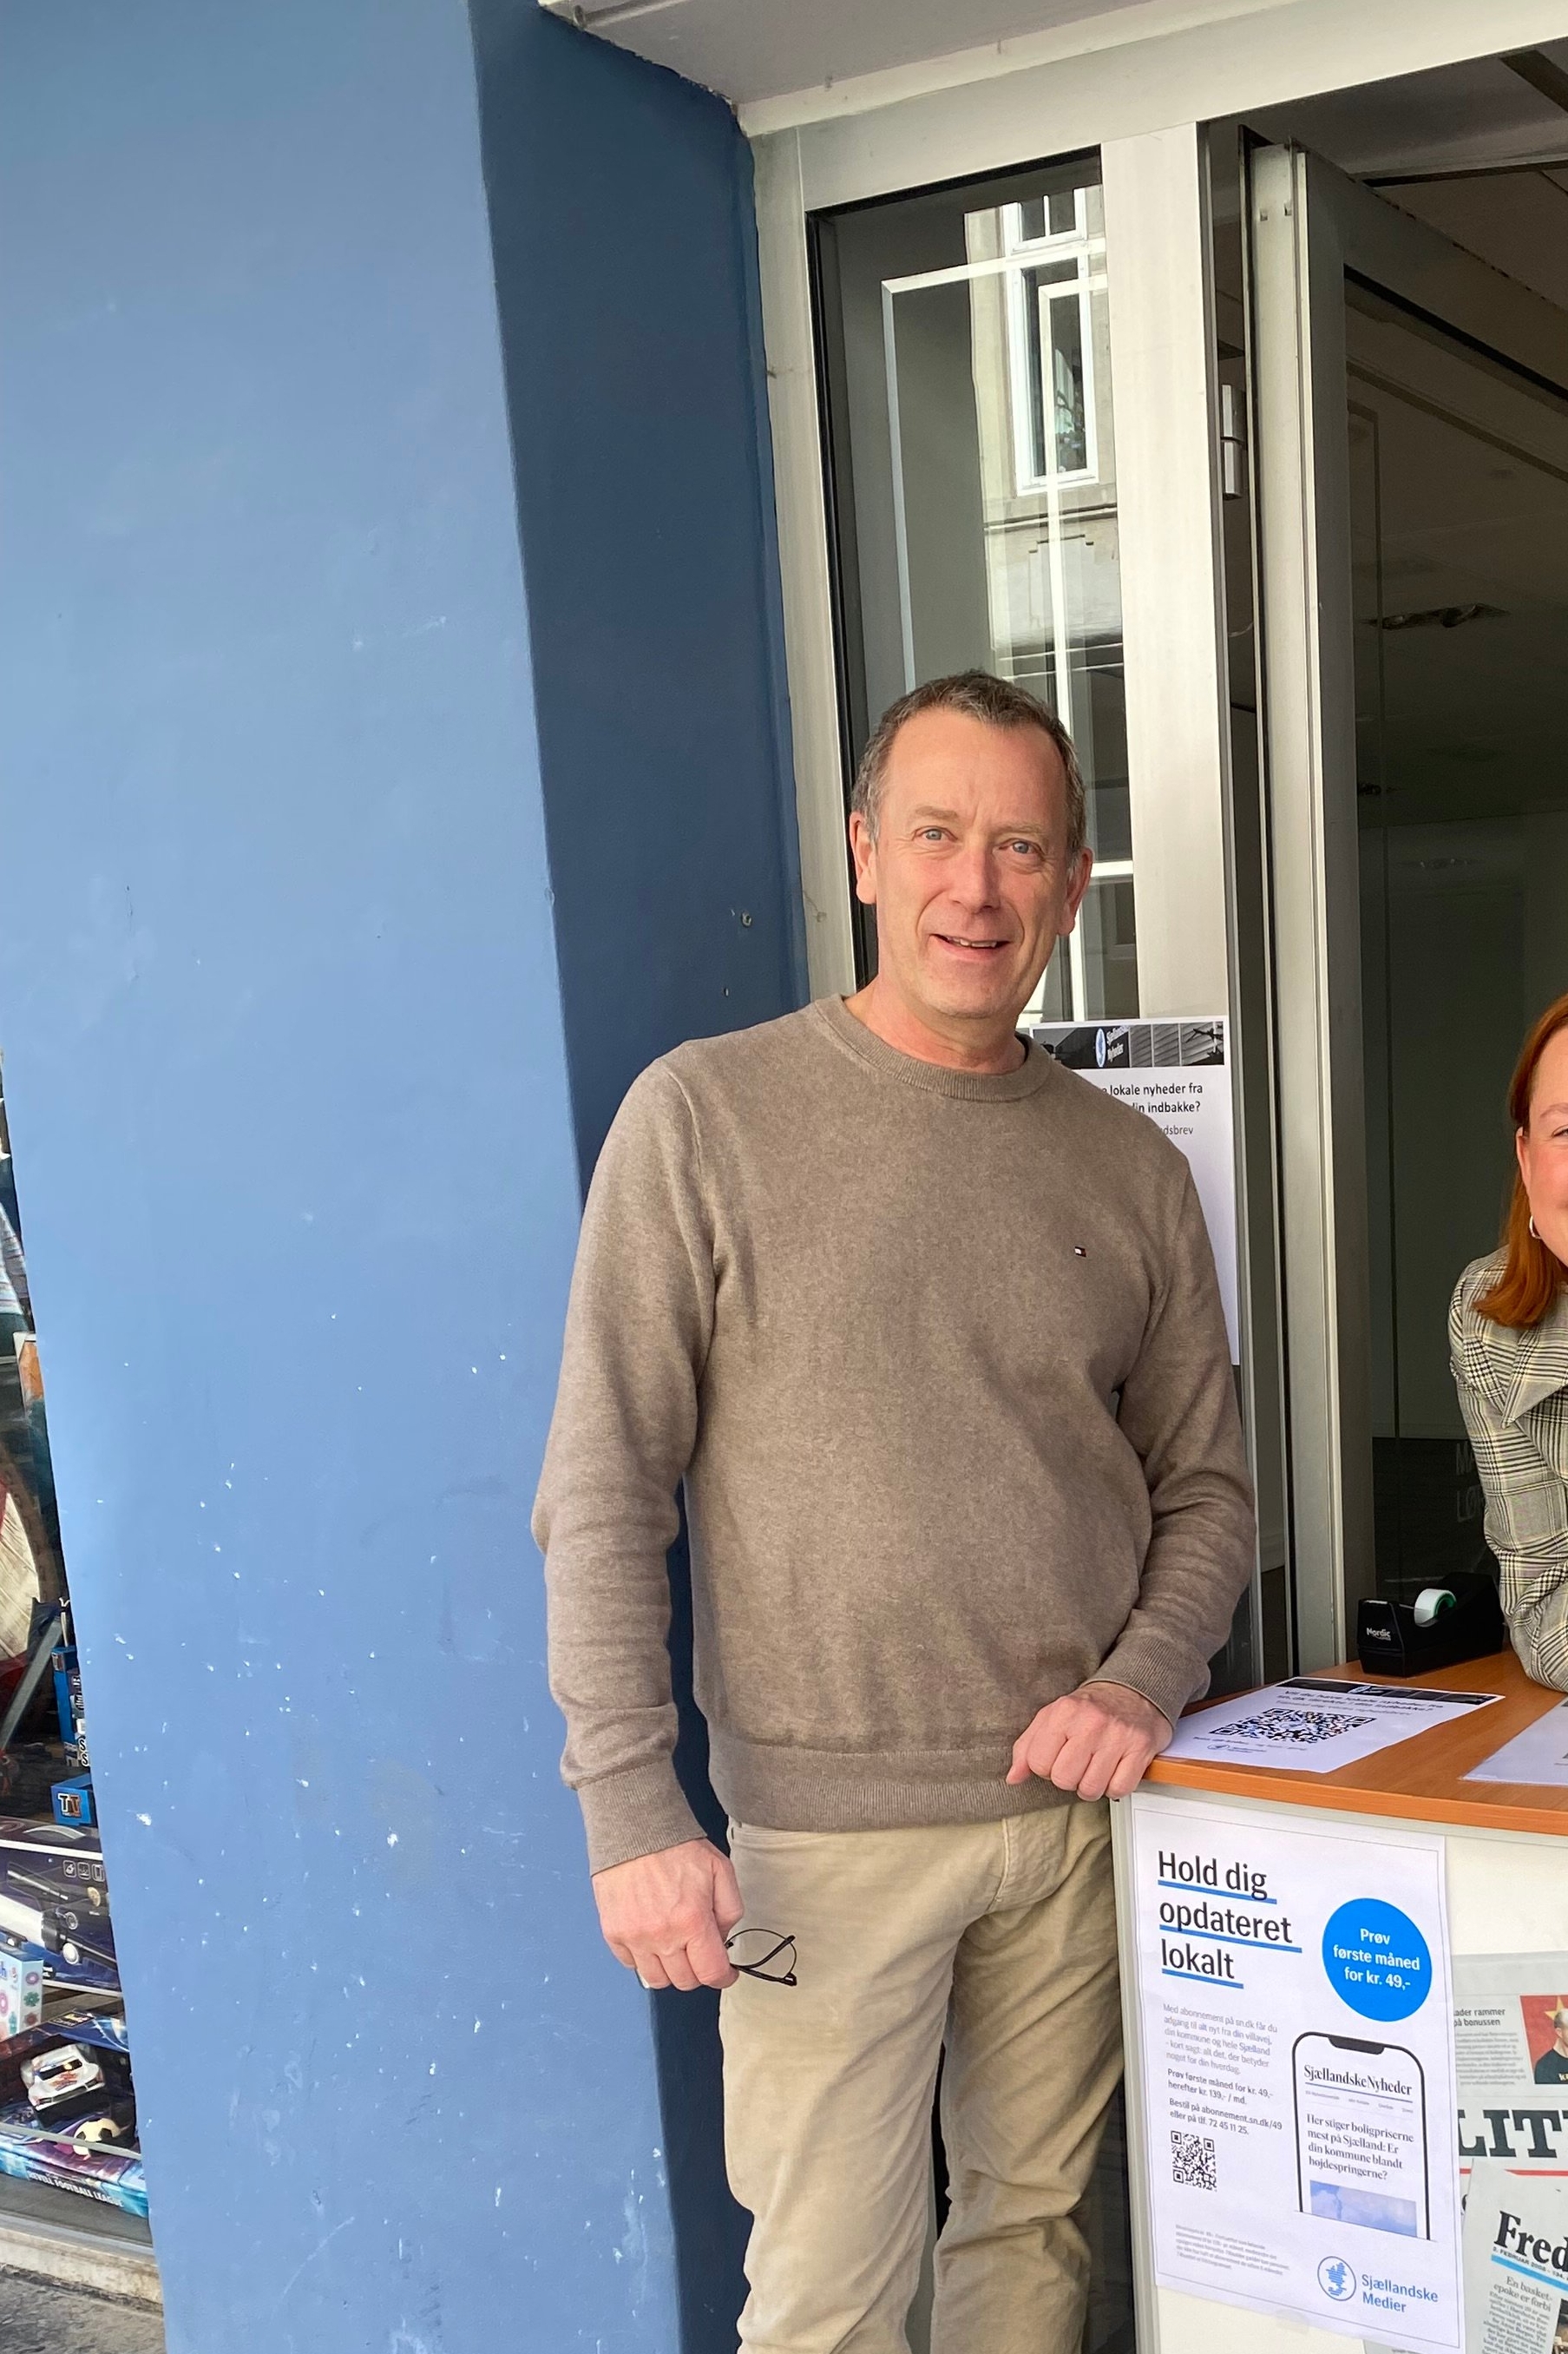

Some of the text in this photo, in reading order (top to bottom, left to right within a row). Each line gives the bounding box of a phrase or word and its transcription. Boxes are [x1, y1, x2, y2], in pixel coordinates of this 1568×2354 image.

[1110, 1084, 1140, 1095] lokale
[1143, 1083, 1186, 1097] nyheder
[1189, 1082, 1203, 1094] fra
[1148, 1101, 1201, 1113] indbakke?
[1160, 1125, 1194, 1135] dsbrev
[1158, 1851, 1268, 1901] Hold dig
[1159, 1902, 1293, 1943] opdateret
[1360, 1928, 1391, 1945] Prøv
[1161, 1938, 1235, 1979] lokalt
[1333, 1944, 1420, 1970] første måned
[1344, 1966, 1411, 1991] for kr. 49,-
[1163, 2003, 1277, 2033] Med abonnement på sn.dk får du
[1165, 2016, 1189, 2029] adgang
[1209, 2026, 1220, 2035] nyt
[1222, 2027, 1231, 2036] fra
[1232, 2029, 1243, 2039] din
[1165, 2028, 1175, 2036] din
[1177, 2029, 1210, 2043] kommune
[1211, 2038, 1221, 2048] og
[1222, 2039, 1237, 2049] hele
[1170, 2040, 1184, 2049] kort
[1228, 2053, 1240, 2061] der
[1241, 2055, 1269, 2067] betyder
[1187, 2055, 1197, 2064] for
[1198, 2057, 1210, 2067] din
[1168, 2068, 1184, 2079] Prøv
[1185, 2072, 1207, 2084] første
[1209, 2079, 1233, 2089] måned
[1235, 2082, 1245, 2092] for
[1247, 2086, 1256, 2094] kr.
[1168, 2079, 1197, 2094] herefter
[1198, 2087, 1208, 2096] kr.
[1233, 2096, 1247, 2105] md.
[1169, 2097, 1190, 2109] Bestil
[1191, 2103, 1200, 2112] på
[1170, 2110, 1186, 2120] eller
[1209, 2118, 1217, 2127] 72
[1219, 2121, 1229, 2130] 45
[1230, 2123, 1236, 2132] 11
[1307, 2114, 1414, 2143] Her stiger boligpriserne
[1308, 2129, 1329, 2140] mest
[1330, 2134, 1342, 2144] på
[1388, 2143, 1399, 2153] Er
[1308, 2142, 1403, 2169] din kommune blandt
[54, 2180, 94, 2199] FOOTBALL
[1493, 2210, 1568, 2272] Fred
[1361, 2274, 1439, 2303] Sjællandske
[1506, 2276, 1519, 2288] En
[1362, 2292, 1407, 2313] Medier
[1493, 2284, 1552, 2311] epoke er forbi
